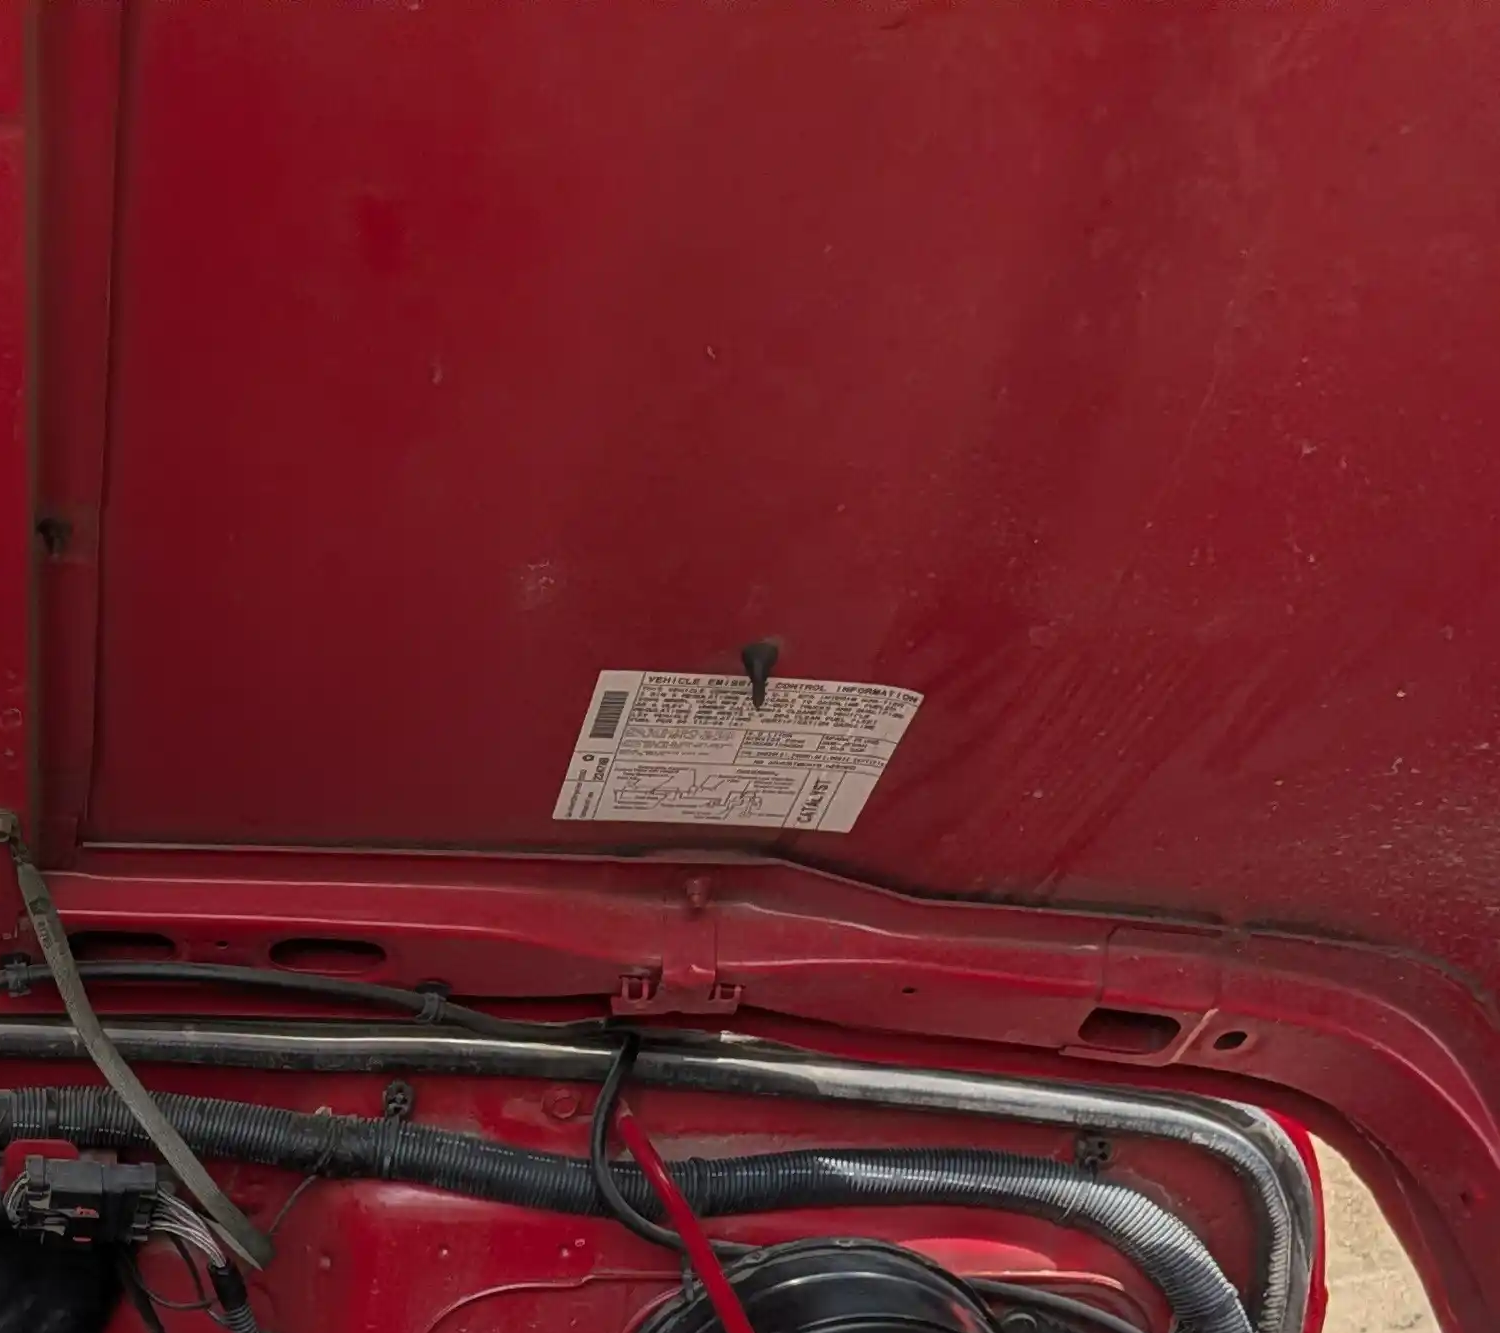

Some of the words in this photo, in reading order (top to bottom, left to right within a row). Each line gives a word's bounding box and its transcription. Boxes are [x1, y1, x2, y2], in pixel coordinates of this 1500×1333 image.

[647, 676, 701, 686] VEHICLE
[775, 682, 827, 693] CONTROL
[836, 686, 919, 704] INFORMATION
[797, 777, 831, 824] CATALYST
